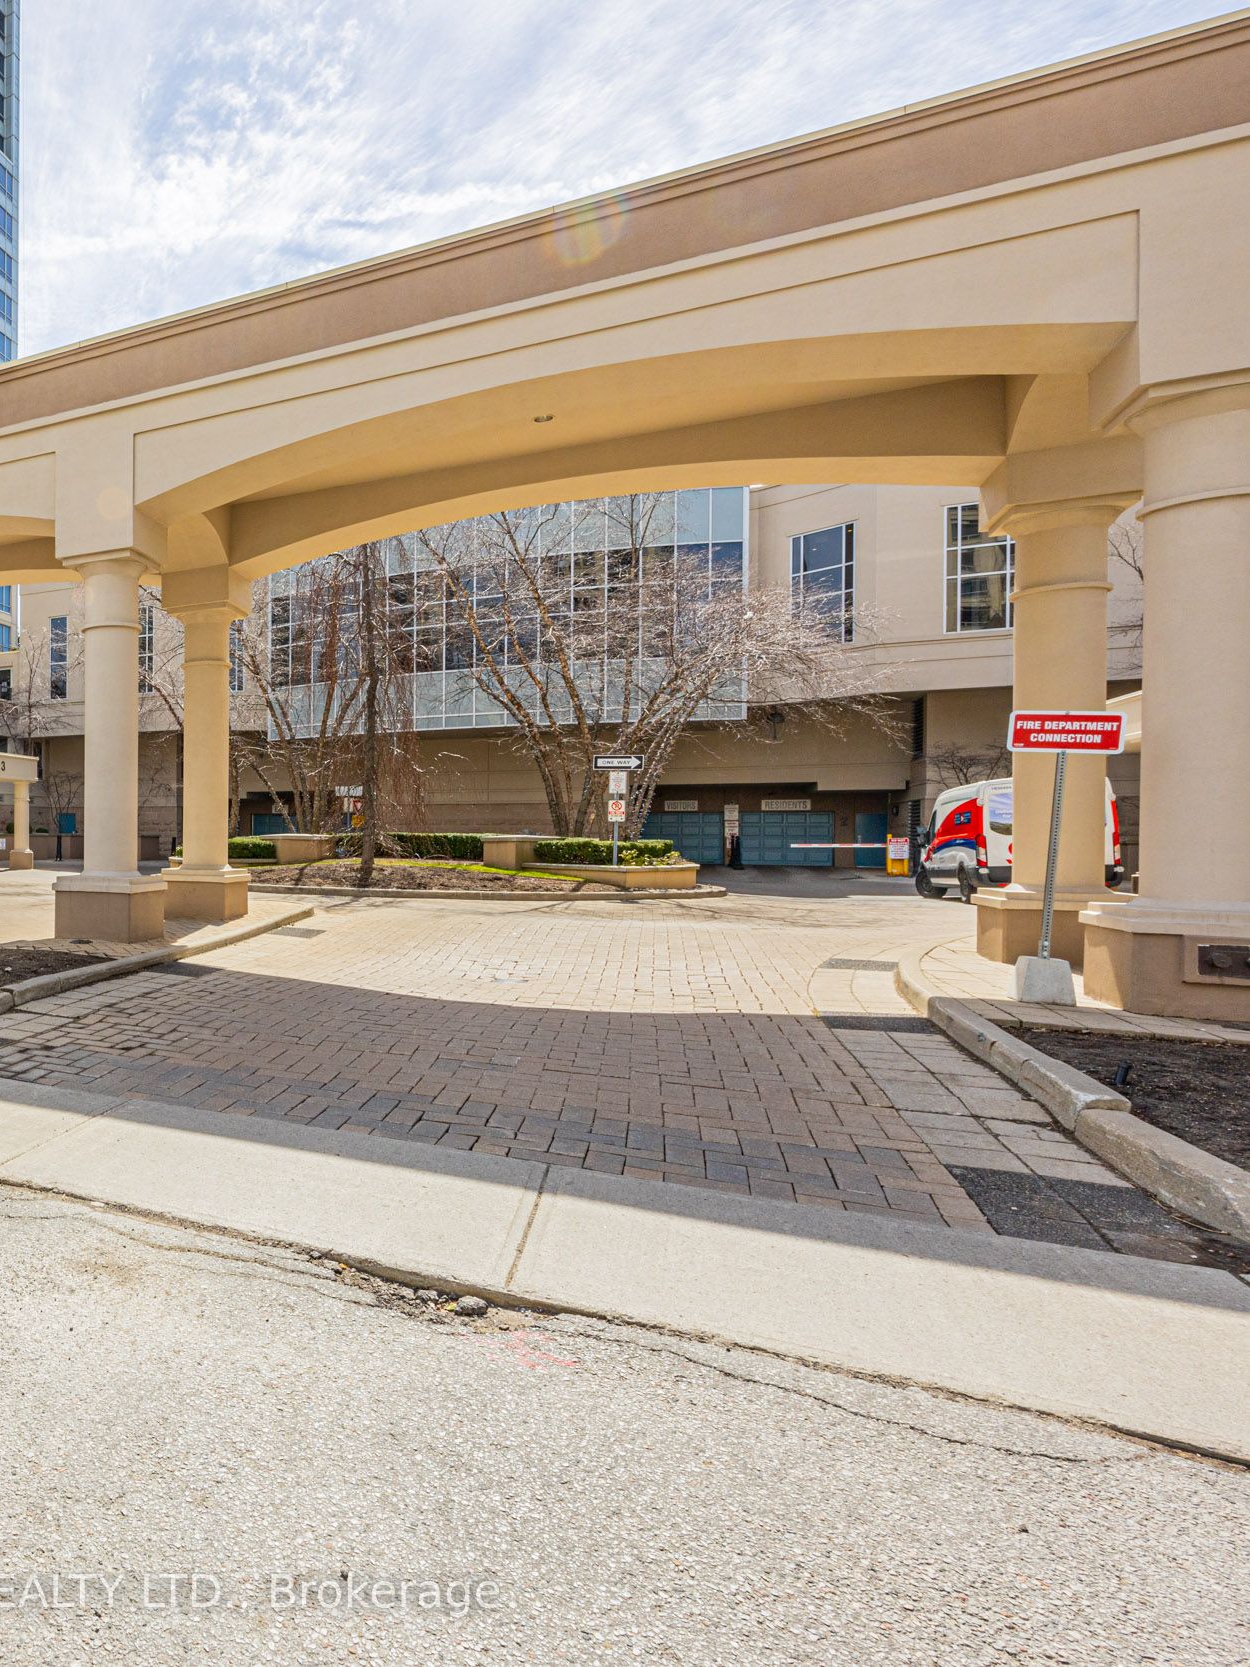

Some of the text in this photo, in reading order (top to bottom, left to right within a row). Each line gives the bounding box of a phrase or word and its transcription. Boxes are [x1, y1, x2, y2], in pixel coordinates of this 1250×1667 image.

[1016, 721, 1119, 731] FIRE DEPARTMENT
[1030, 733, 1102, 743] CONNECTION
[0, 760, 6, 771] 3
[666, 801, 696, 810] VISITORS
[764, 801, 808, 810] RESIDENTS
